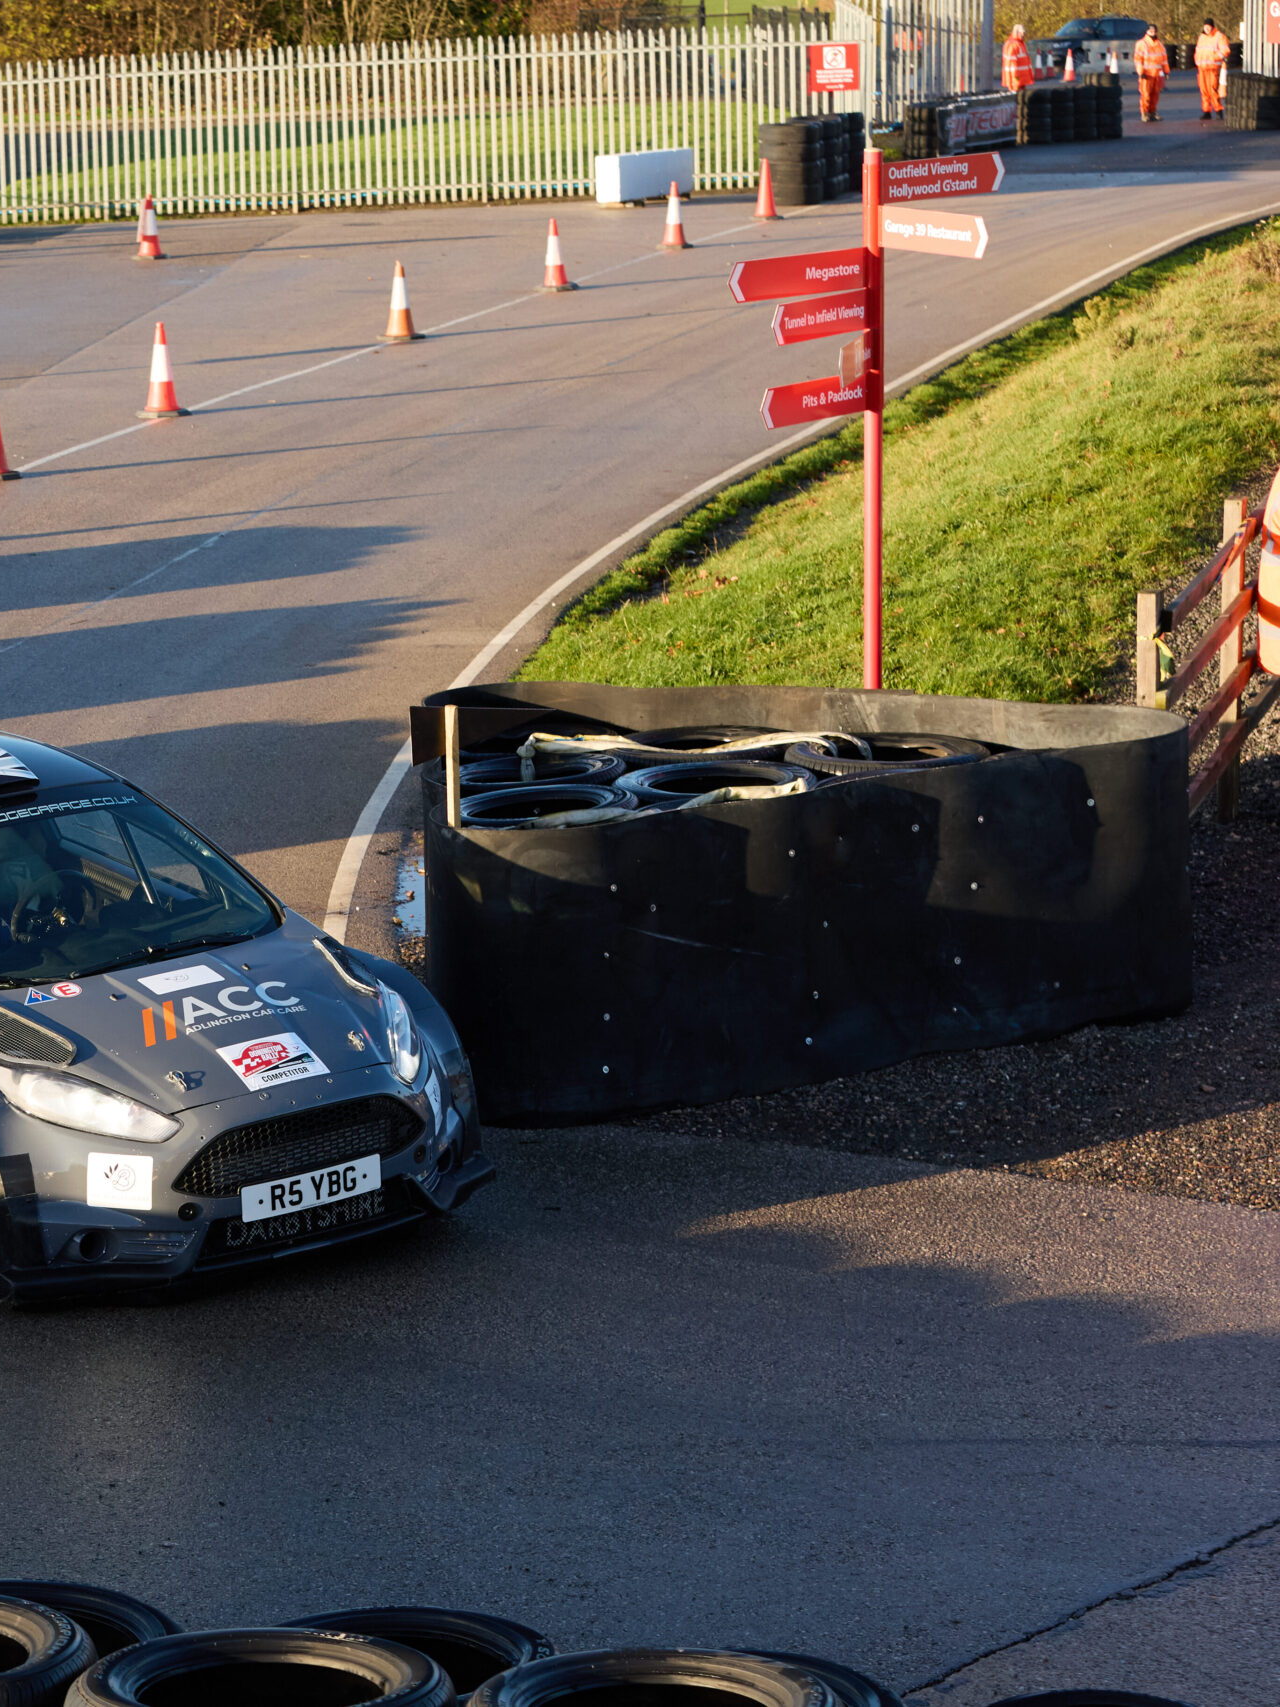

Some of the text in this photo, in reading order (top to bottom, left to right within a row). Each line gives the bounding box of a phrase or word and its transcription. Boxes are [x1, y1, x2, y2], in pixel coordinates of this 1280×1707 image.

[888, 160, 969, 179] Outfield Viewing
[889, 176, 977, 198] Hollywood G'stand
[884, 219, 973, 242] Garage 39 Restaurant
[805, 264, 860, 281] Megastore
[784, 304, 865, 330] Tunnel to Infield Viewing
[802, 385, 863, 408] Pits & Paddock
[56, 984, 73, 996] E
[181, 981, 301, 1026] ACC
[185, 1005, 308, 1035] ADLINGTON CAR CARE
[248, 1044, 283, 1058] DONINGTON
[261, 1051, 280, 1061] RALLY
[261, 1066, 310, 1083] COMPETITOR
[270, 1165, 357, 1211] R5 YBG
